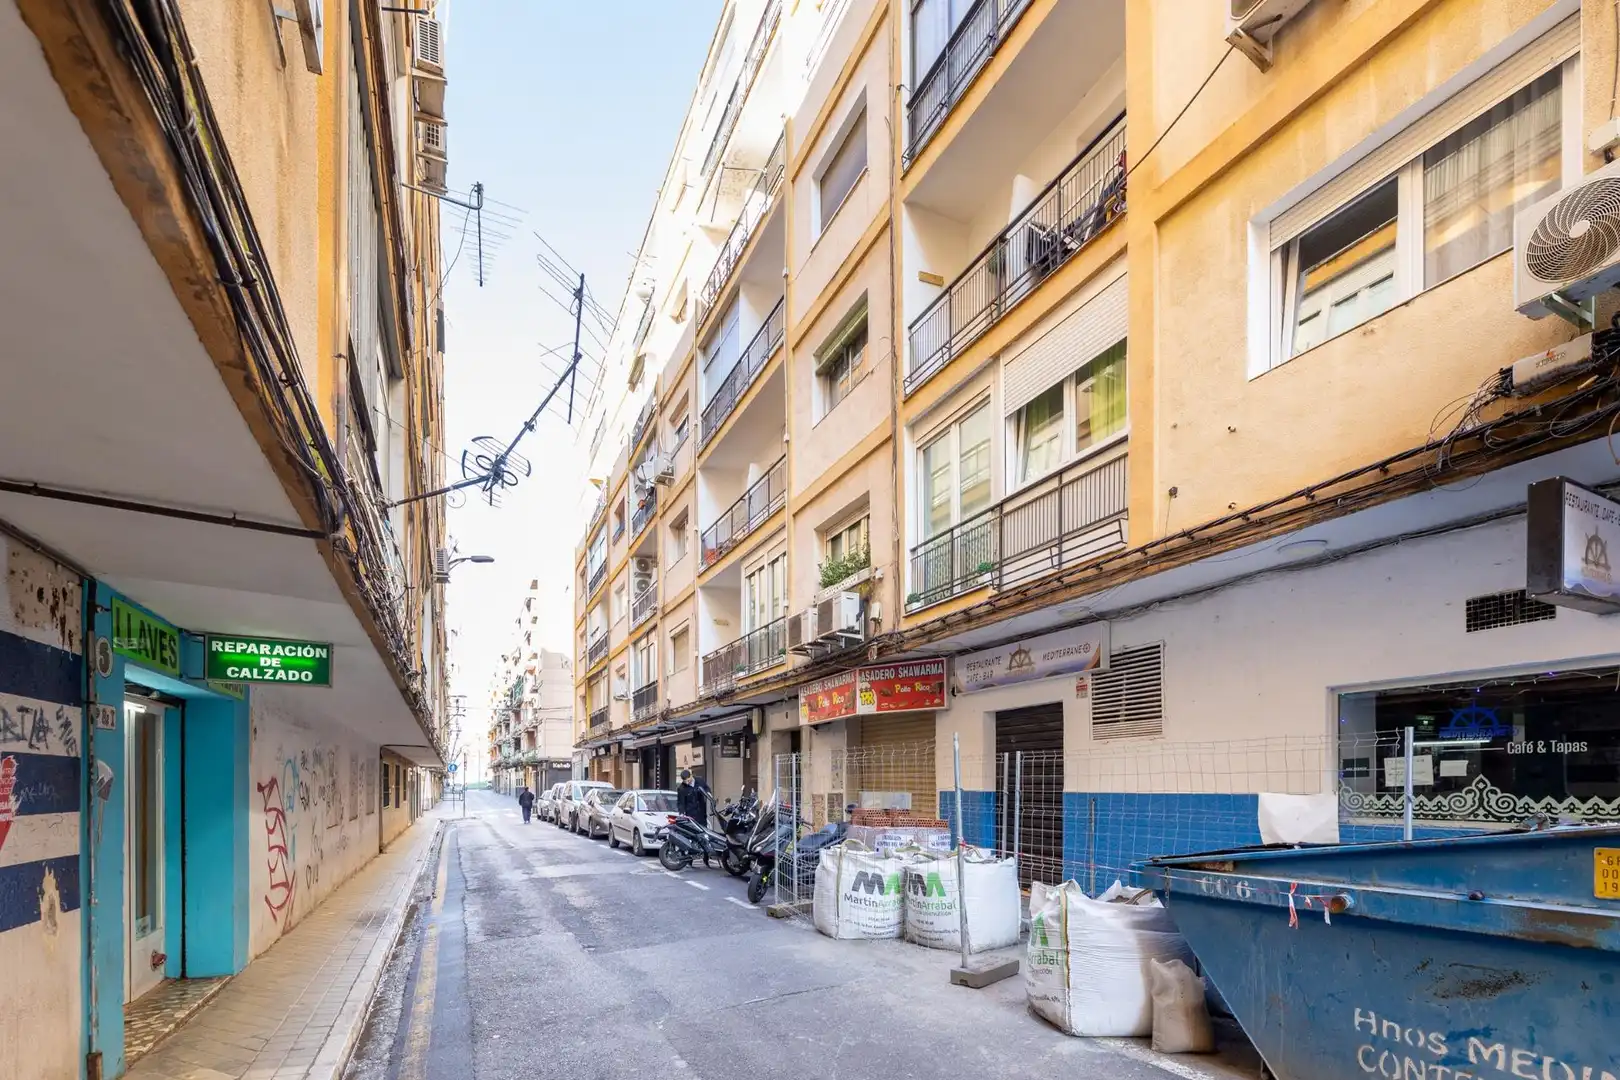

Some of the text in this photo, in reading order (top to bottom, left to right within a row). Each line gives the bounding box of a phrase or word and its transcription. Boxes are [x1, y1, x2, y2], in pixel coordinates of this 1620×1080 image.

[115, 606, 177, 669] LLAVES
[211, 640, 327, 659] REPARACIÓN
[260, 657, 282, 667] DE
[966, 655, 1002, 673] RESTAURANTE
[226, 666, 313, 682] CALZADO
[861, 662, 944, 682] ASADERO SHAWARMA
[915, 681, 931, 692] Rico
[1507, 739, 1588, 755] Café & Tapas
[1354, 1007, 1449, 1056] Hnos
